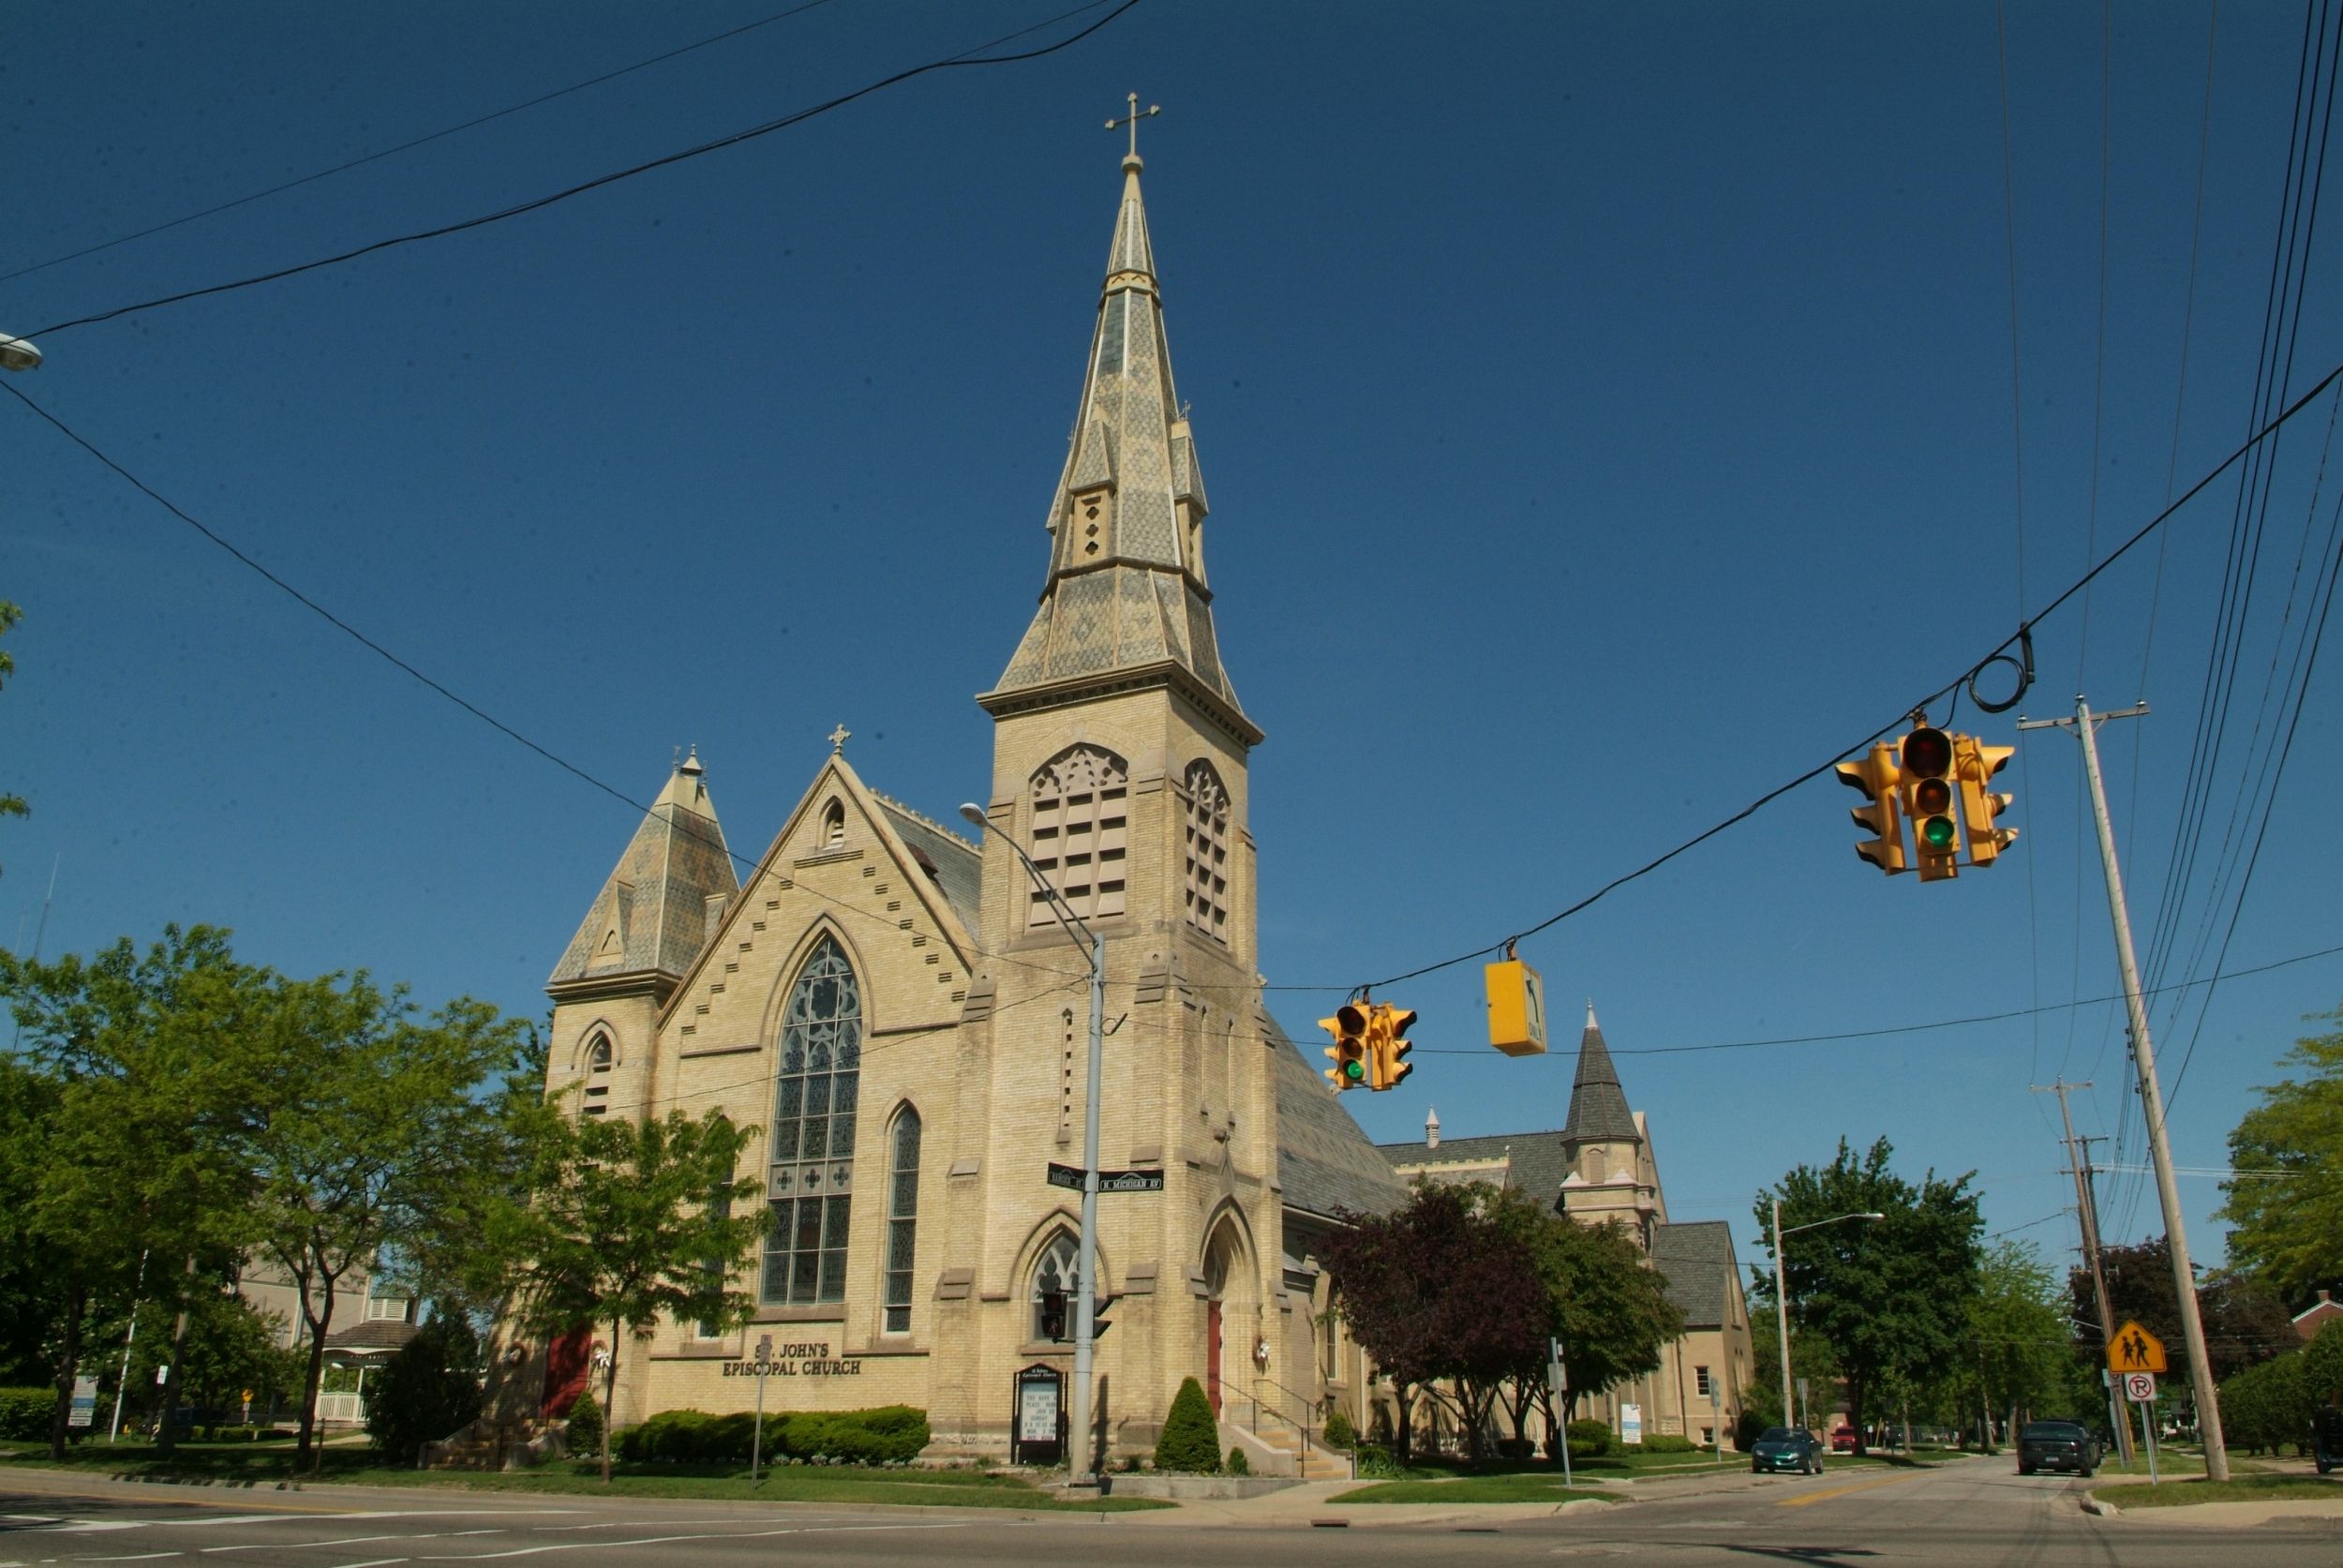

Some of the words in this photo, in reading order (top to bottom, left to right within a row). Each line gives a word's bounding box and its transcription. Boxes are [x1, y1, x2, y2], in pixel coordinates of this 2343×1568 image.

[1112, 1179, 1146, 1189] MICHIGAN
[1149, 1178, 1159, 1188] AV
[780, 1343, 828, 1358] JOHN'S
[723, 1361, 797, 1377] EPISCOPAL
[802, 1360, 861, 1376] CHURCH
